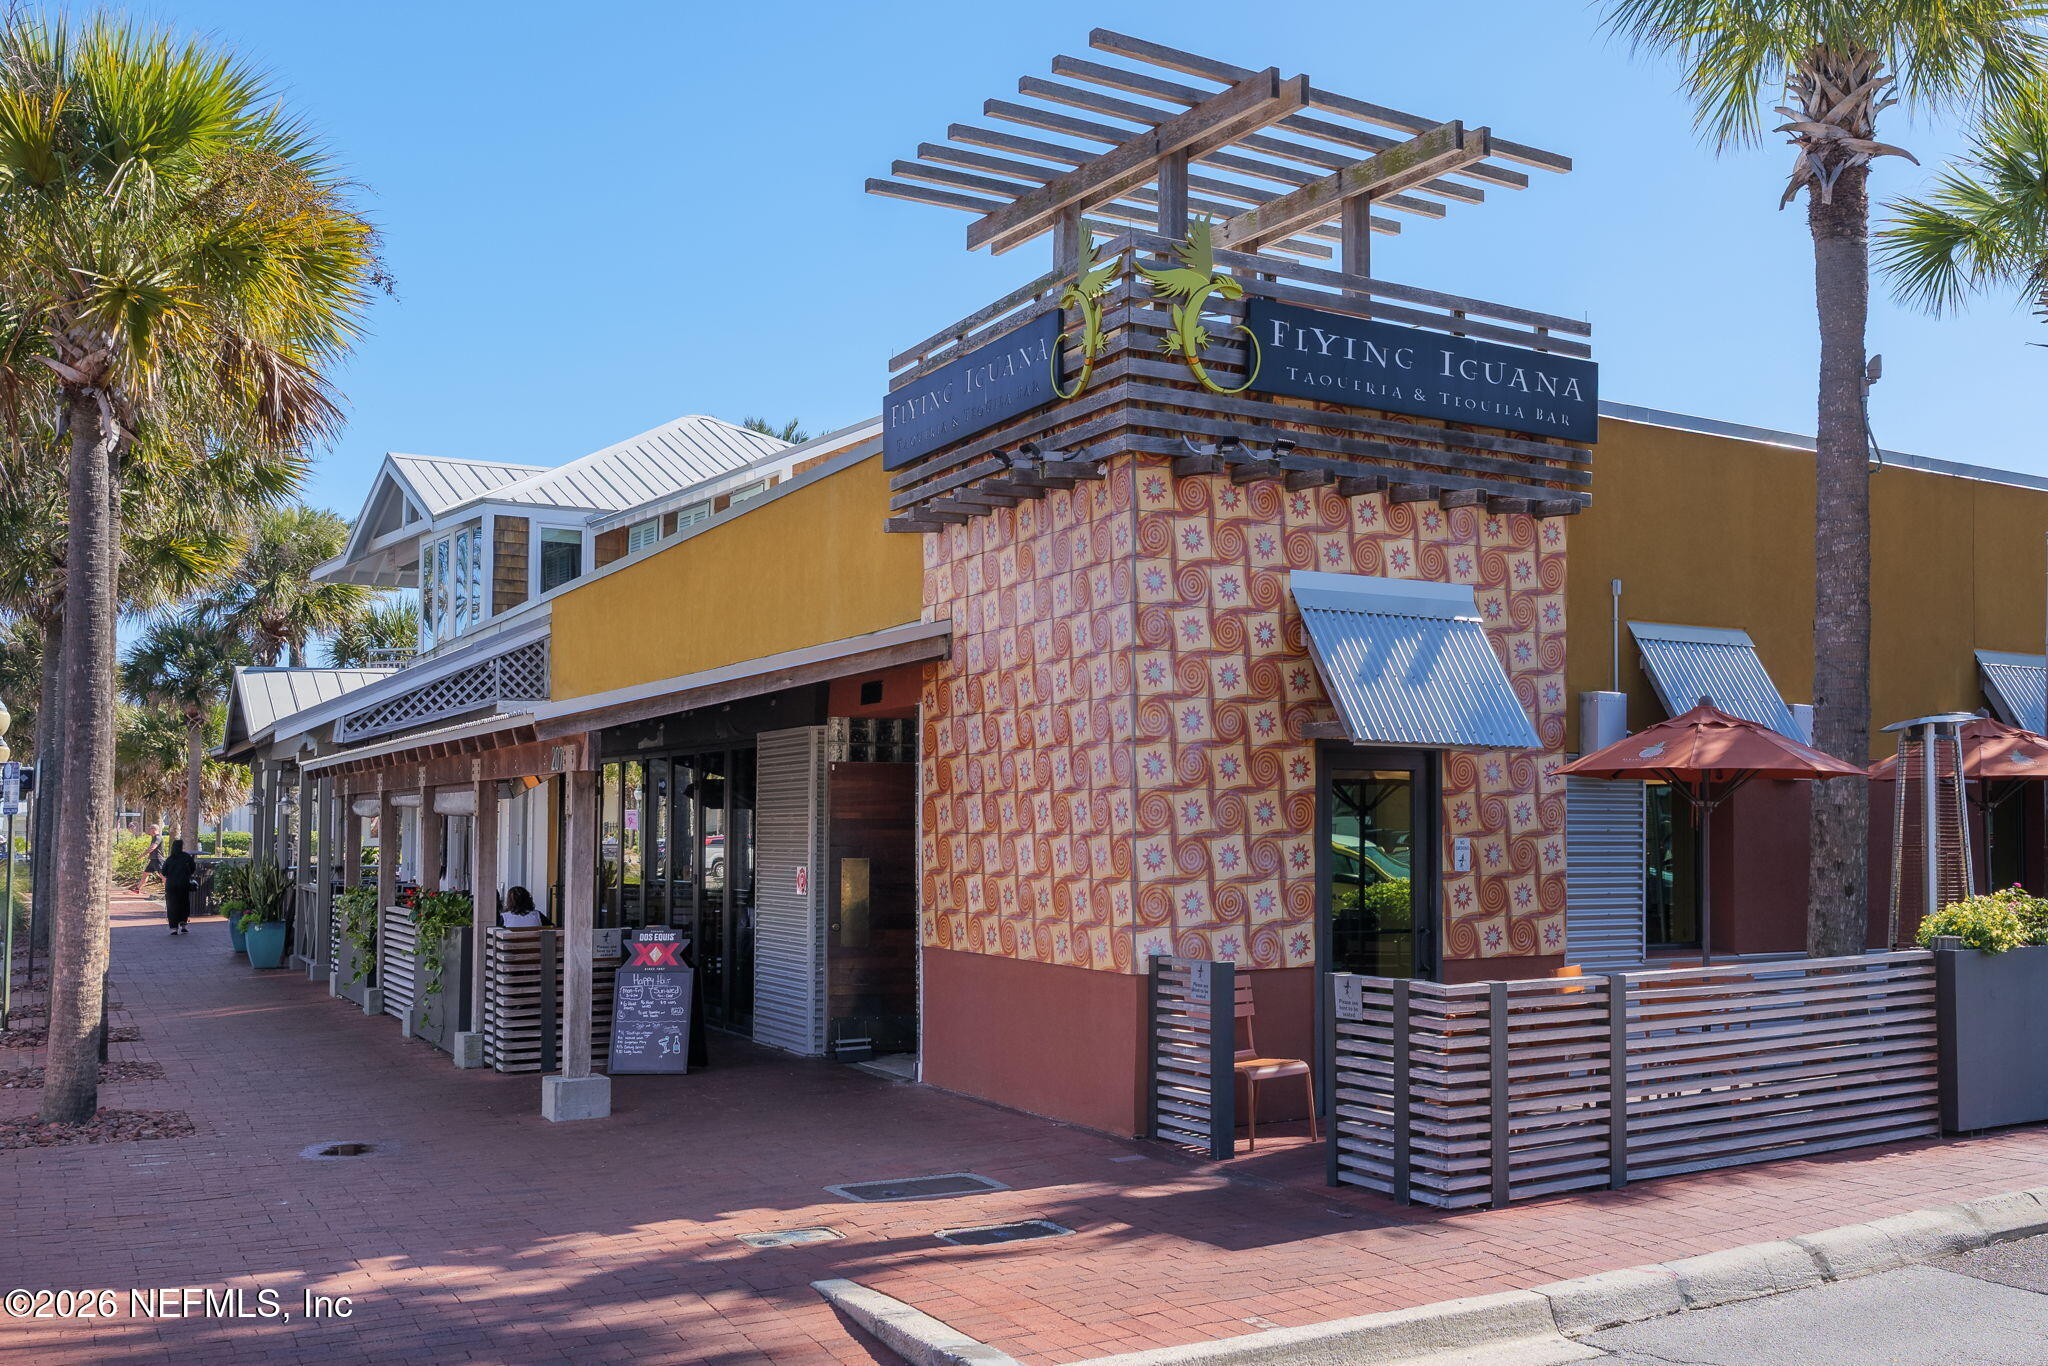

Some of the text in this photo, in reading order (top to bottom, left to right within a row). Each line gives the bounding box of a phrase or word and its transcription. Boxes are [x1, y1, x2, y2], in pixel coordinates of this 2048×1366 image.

[891, 338, 1049, 430] FLYING IGUANA
[1269, 319, 1584, 403] FLYING IGUANA
[1286, 366, 1571, 427] TAQUERIA & TEQUILA BAR
[632, 943, 680, 966] XX
[639, 933, 674, 942] DOS EQUIS
